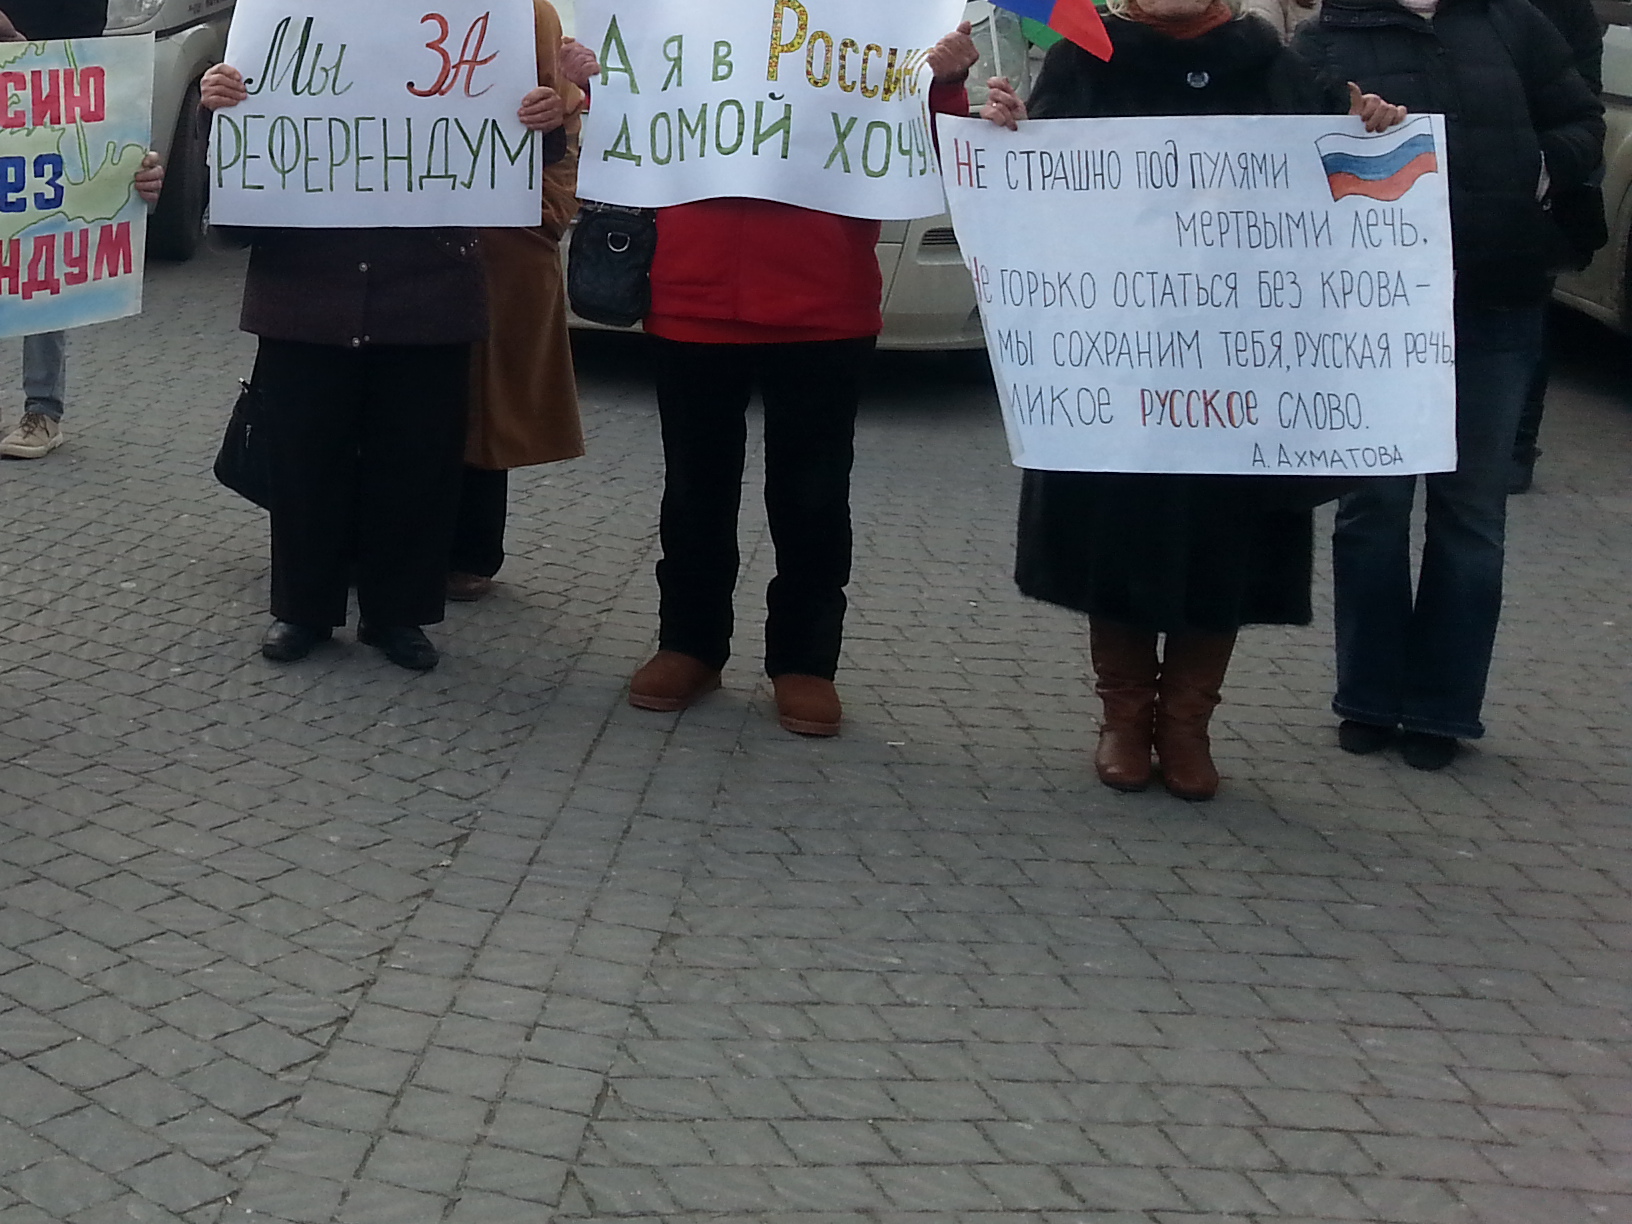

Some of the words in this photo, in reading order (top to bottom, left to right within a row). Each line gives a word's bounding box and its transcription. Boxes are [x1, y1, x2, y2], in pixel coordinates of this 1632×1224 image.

[244, 16, 353, 96] Мы
[406, 11, 500, 97] ЗА
[599, 14, 640, 95] А
[217, 113, 535, 193] РЕФЕРЕНДУМ
[1005, 149, 1121, 191] СТРАШНО
[1189, 150, 1289, 190] ПУЛЯМИ
[1000, 269, 1096, 309] ГОРЬКО
[1113, 270, 1239, 309] ОСТАТЬСЯ
[997, 329, 1034, 367] МЫ
[1052, 328, 1203, 370] СОХРАНИМ
[1294, 330, 1392, 370] РУССКАЯ
[1277, 442, 1405, 471] АХМАТОВА
